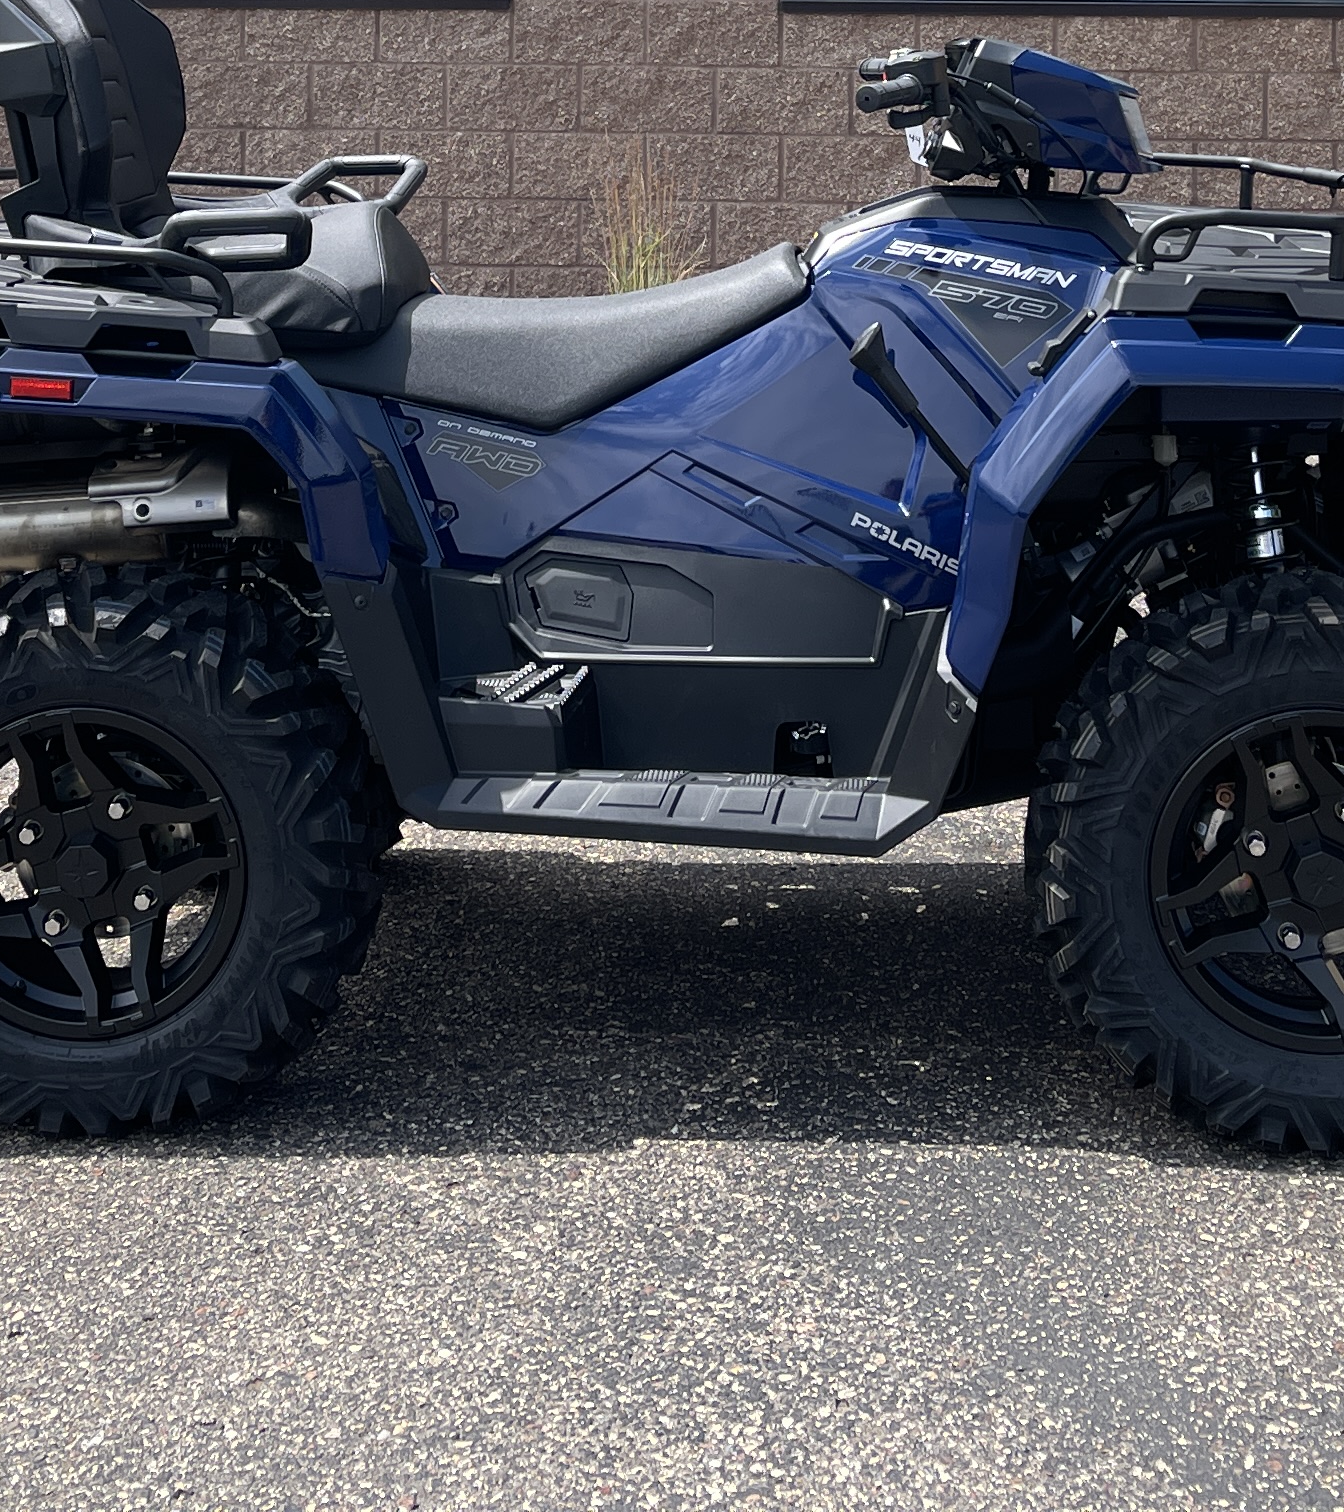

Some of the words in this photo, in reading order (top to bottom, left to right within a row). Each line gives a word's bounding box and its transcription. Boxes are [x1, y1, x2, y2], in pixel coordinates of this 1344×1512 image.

[884, 238, 1077, 288] SPORTSMAN
[928, 280, 1058, 319] 570
[467, 426, 537, 448] DEMAND
[426, 438, 542, 476] AWD
[850, 511, 959, 576] POLARIS
